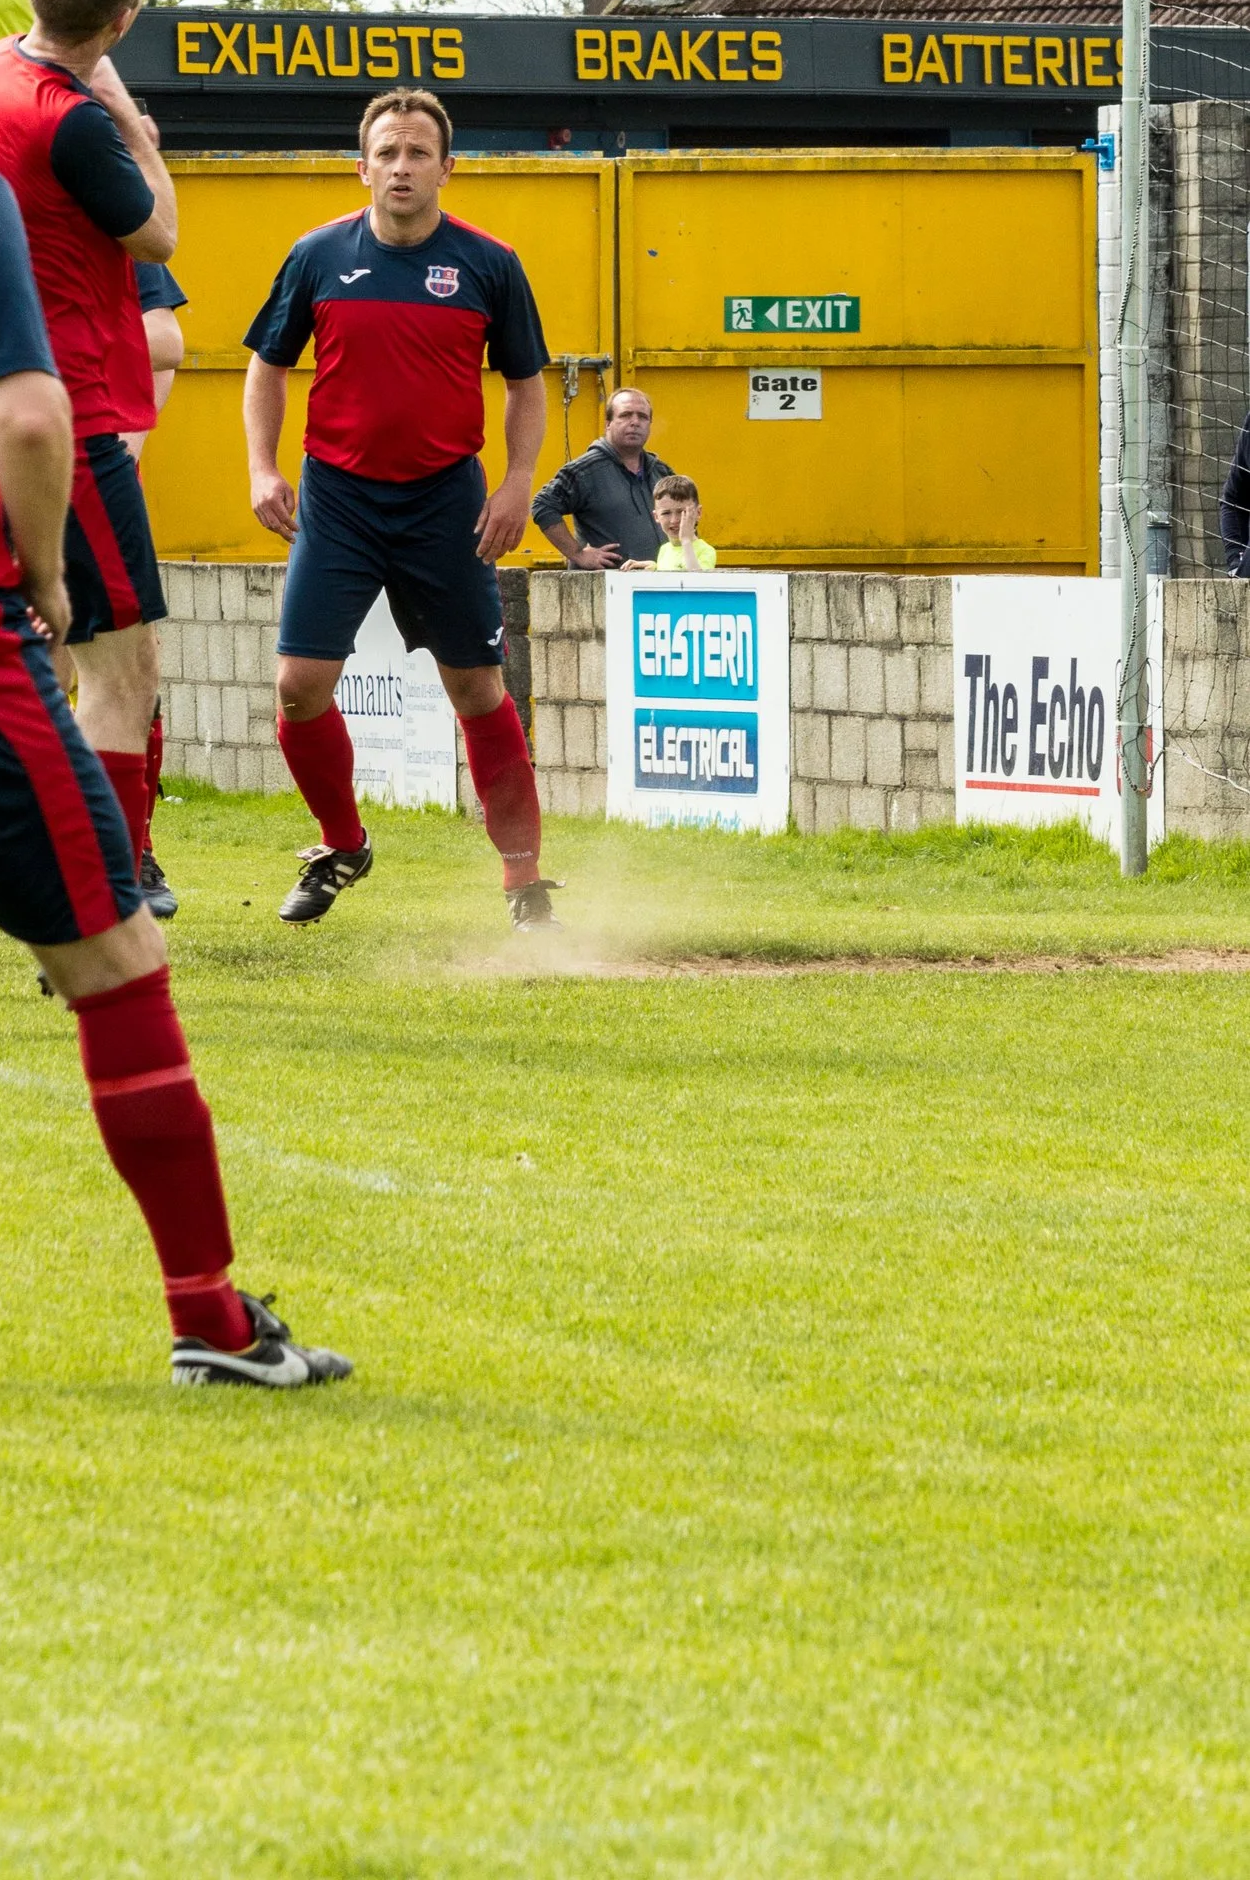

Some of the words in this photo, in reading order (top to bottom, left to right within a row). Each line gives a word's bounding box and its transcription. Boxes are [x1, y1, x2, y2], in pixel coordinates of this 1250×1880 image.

[177, 22, 465, 79] EXHAUSTS
[575, 29, 783, 81] BRAKES
[882, 33, 1123, 86] BATTERIE
[786, 301, 852, 328] EXIT
[752, 375, 817, 392] Gate
[779, 394, 796, 410] 2
[639, 613, 753, 687] EASTERN
[334, 662, 404, 717] nnants
[964, 654, 1018, 777] The
[1028, 656, 1104, 782] Echo
[639, 725, 754, 782] ELECTRICAL
